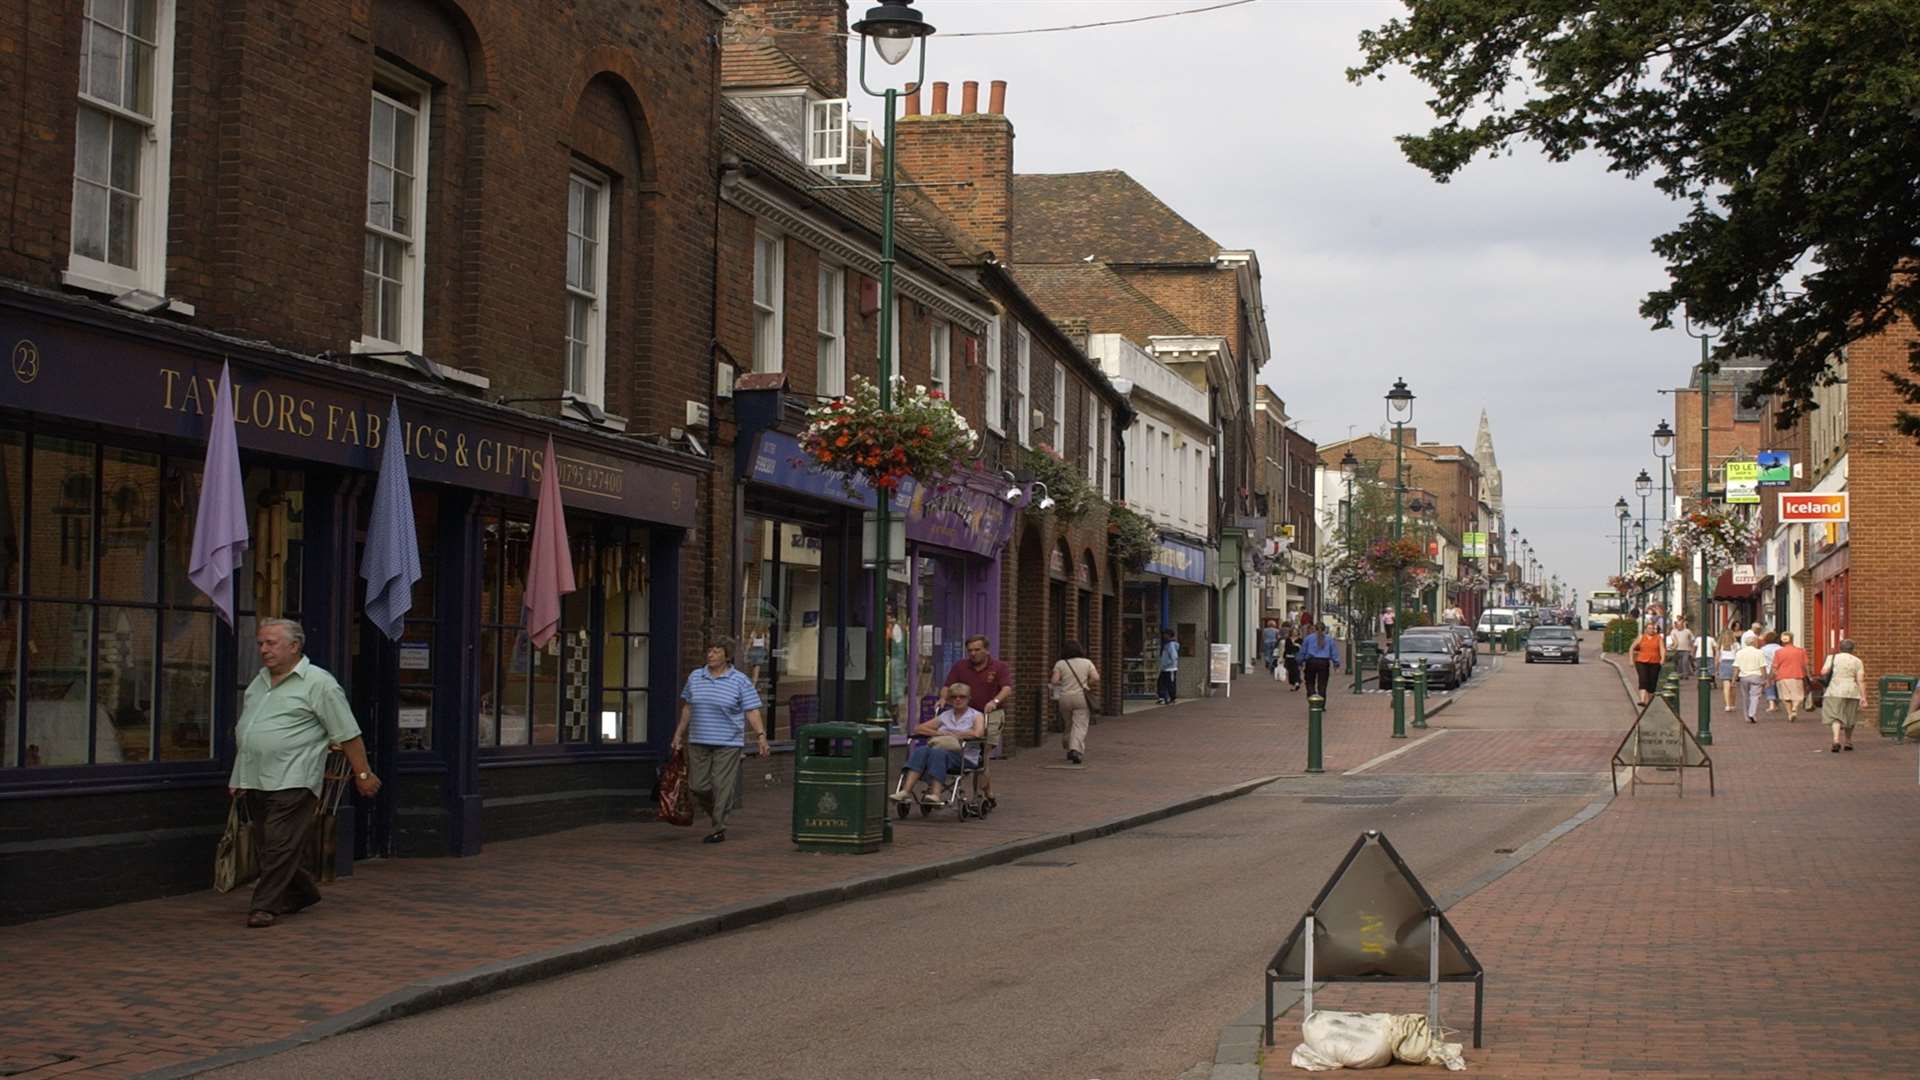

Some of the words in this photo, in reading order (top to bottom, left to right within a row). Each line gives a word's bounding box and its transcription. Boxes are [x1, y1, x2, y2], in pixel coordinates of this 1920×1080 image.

[18, 347, 36, 376] 23
[327, 404, 448, 463] FABICS
[455, 433, 469, 468] &
[477, 438, 543, 482] GIFTS
[1729, 463, 1740, 471] TO
[1743, 463, 1757, 471] LET
[1786, 502, 1841, 514] Iceland
